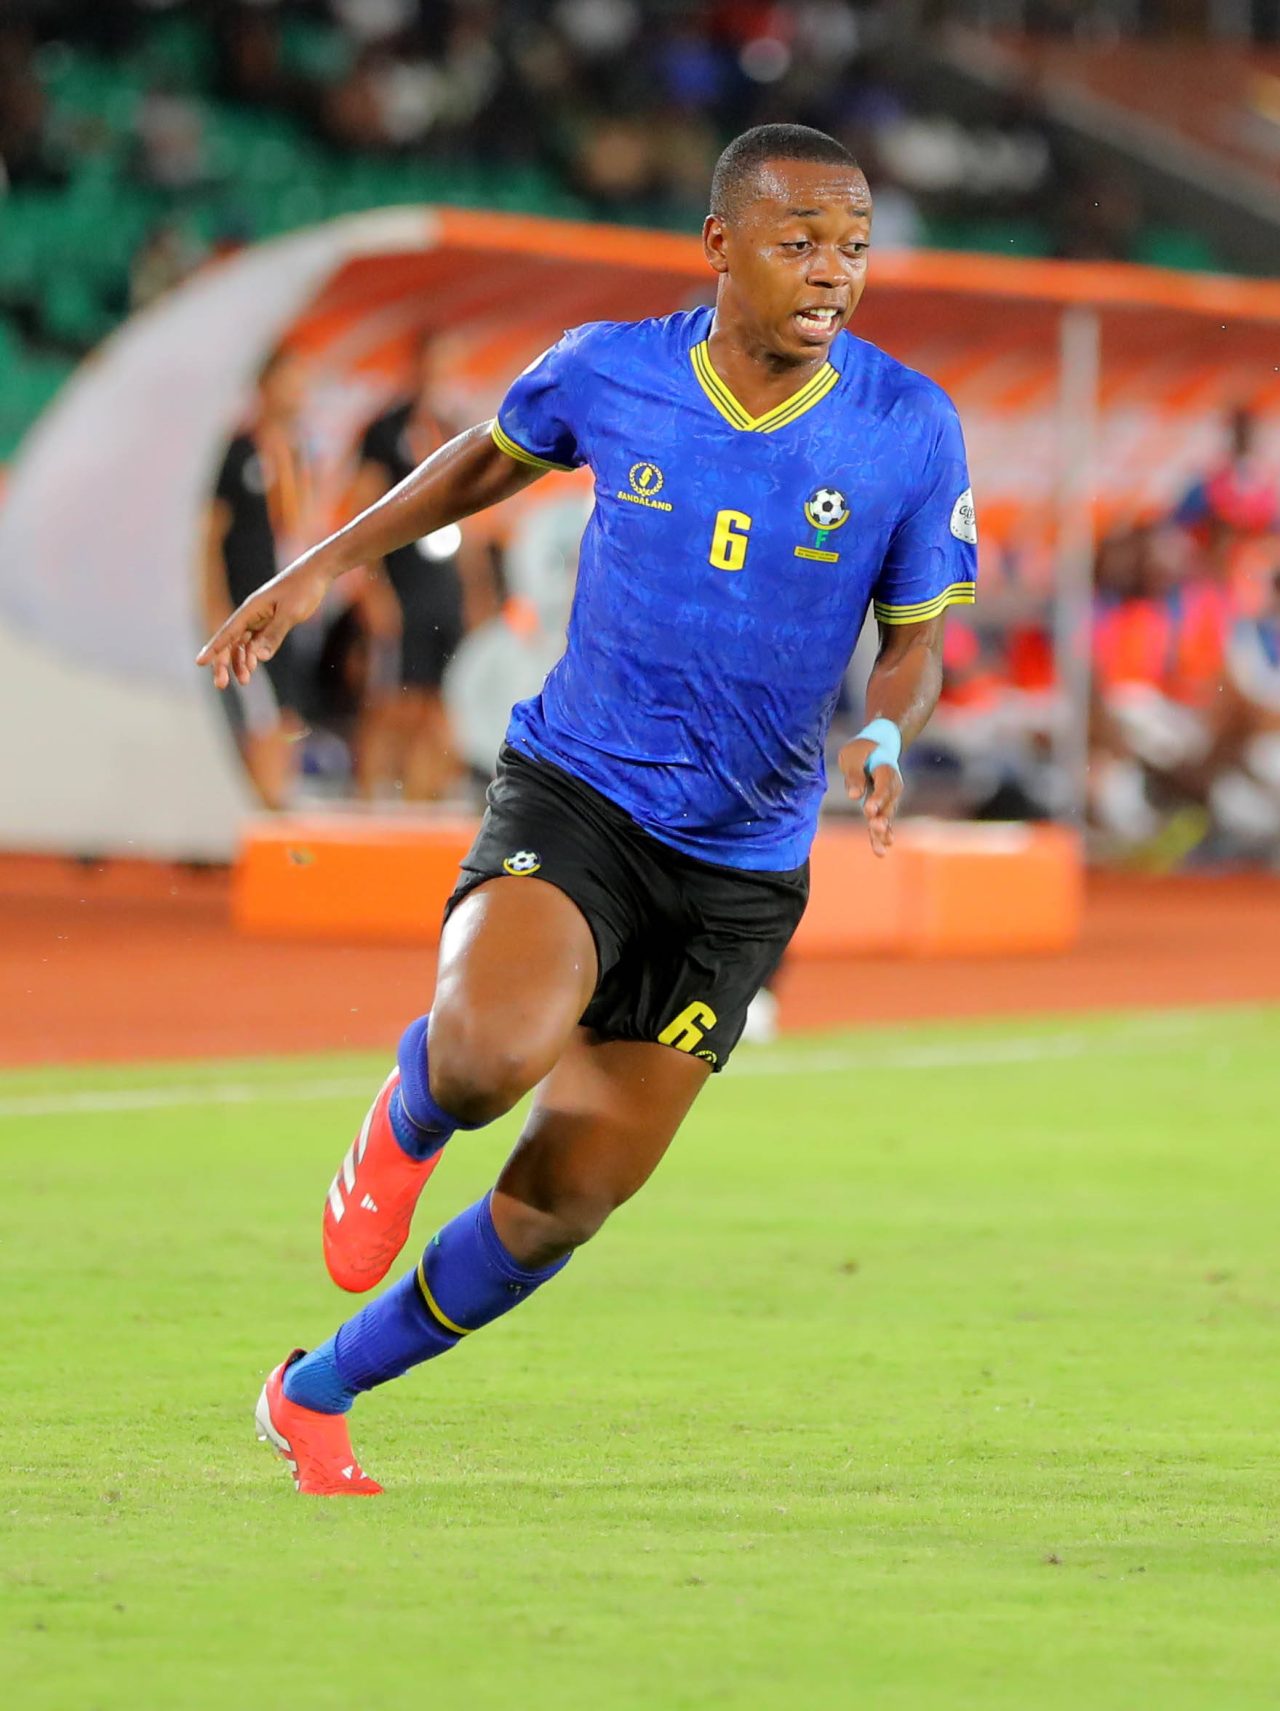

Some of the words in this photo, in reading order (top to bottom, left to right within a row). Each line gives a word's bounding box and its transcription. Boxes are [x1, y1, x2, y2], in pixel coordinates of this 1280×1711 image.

[617, 490, 672, 511] SANDALAND
[709, 510, 752, 571] 6
[658, 1001, 717, 1053] 6
